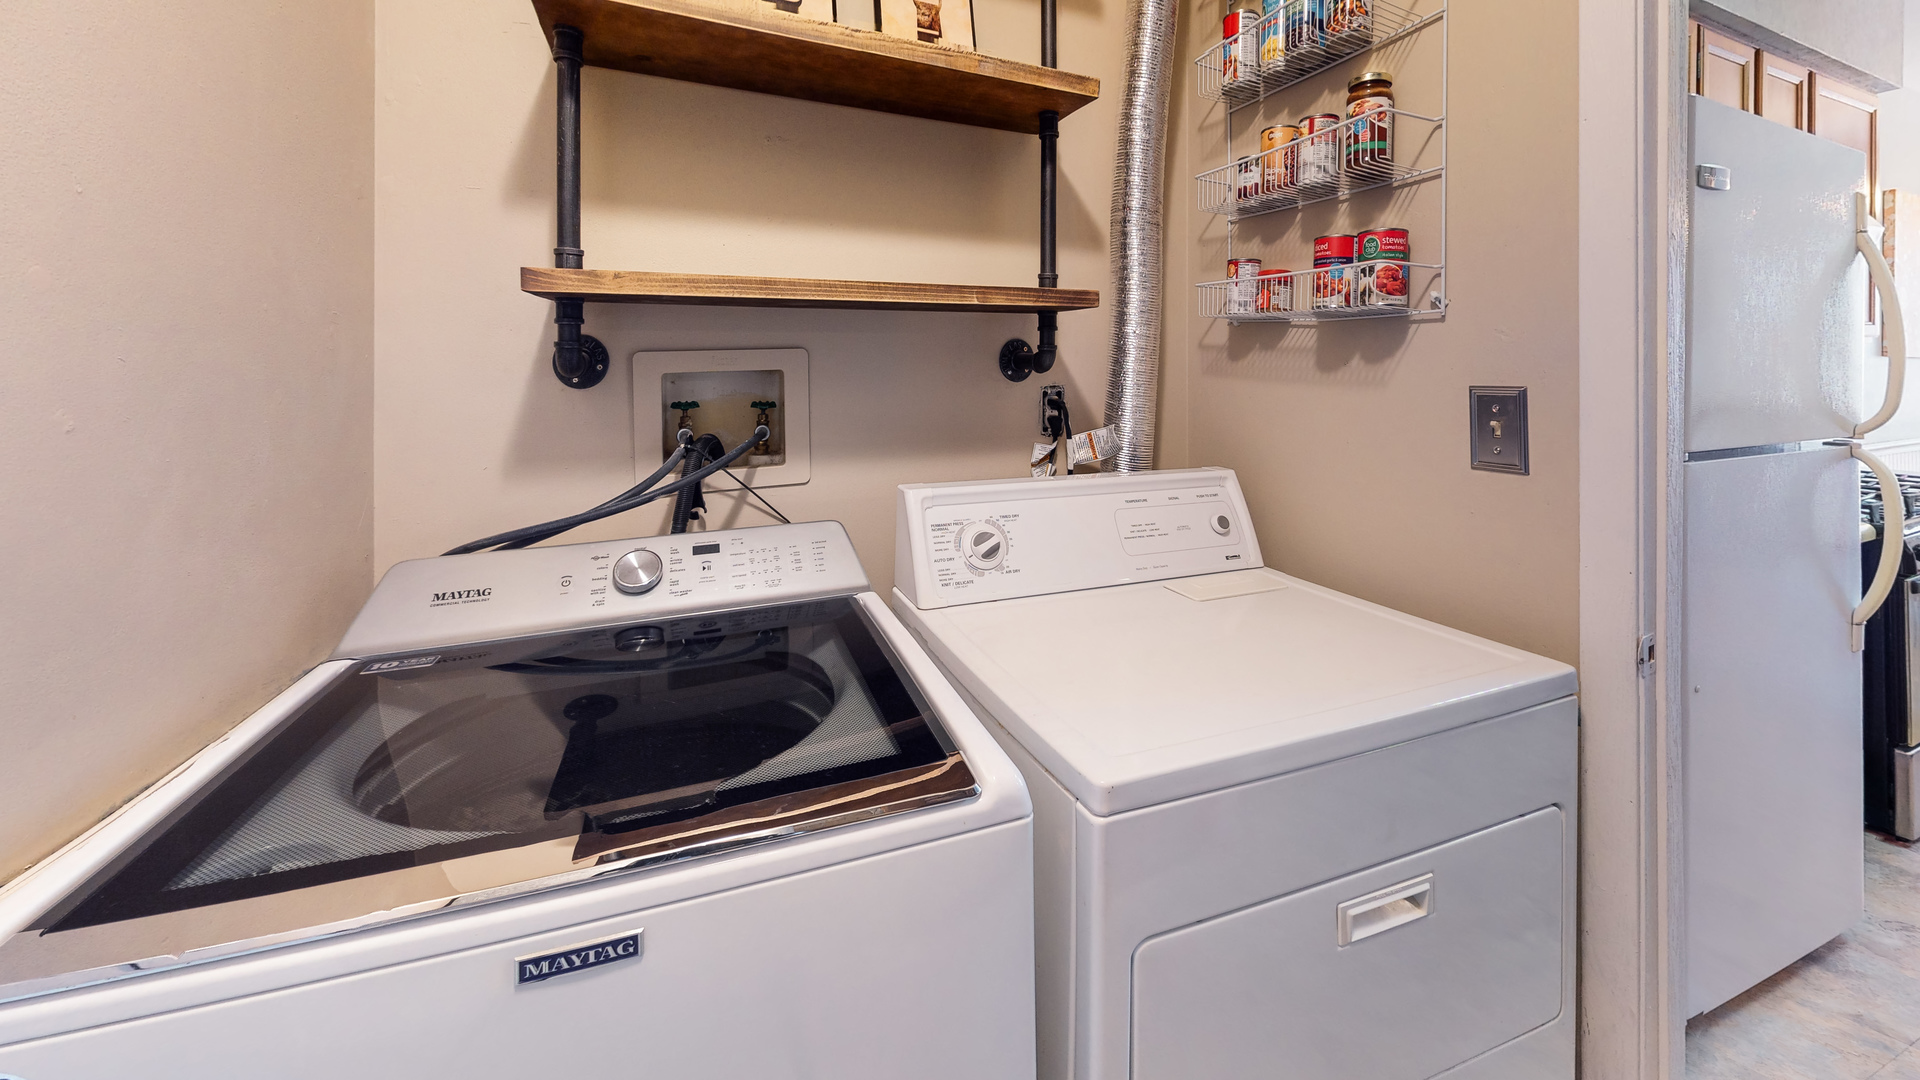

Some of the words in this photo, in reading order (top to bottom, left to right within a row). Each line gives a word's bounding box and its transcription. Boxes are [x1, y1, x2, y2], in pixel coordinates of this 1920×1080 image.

[1315, 242, 1328, 251] iced
[1382, 236, 1406, 245] stewed
[431, 588, 492, 602] MAYTAG
[370, 661, 399, 670] 10
[403, 656, 435, 664] YEAR
[523, 940, 636, 979] MAYTAG
